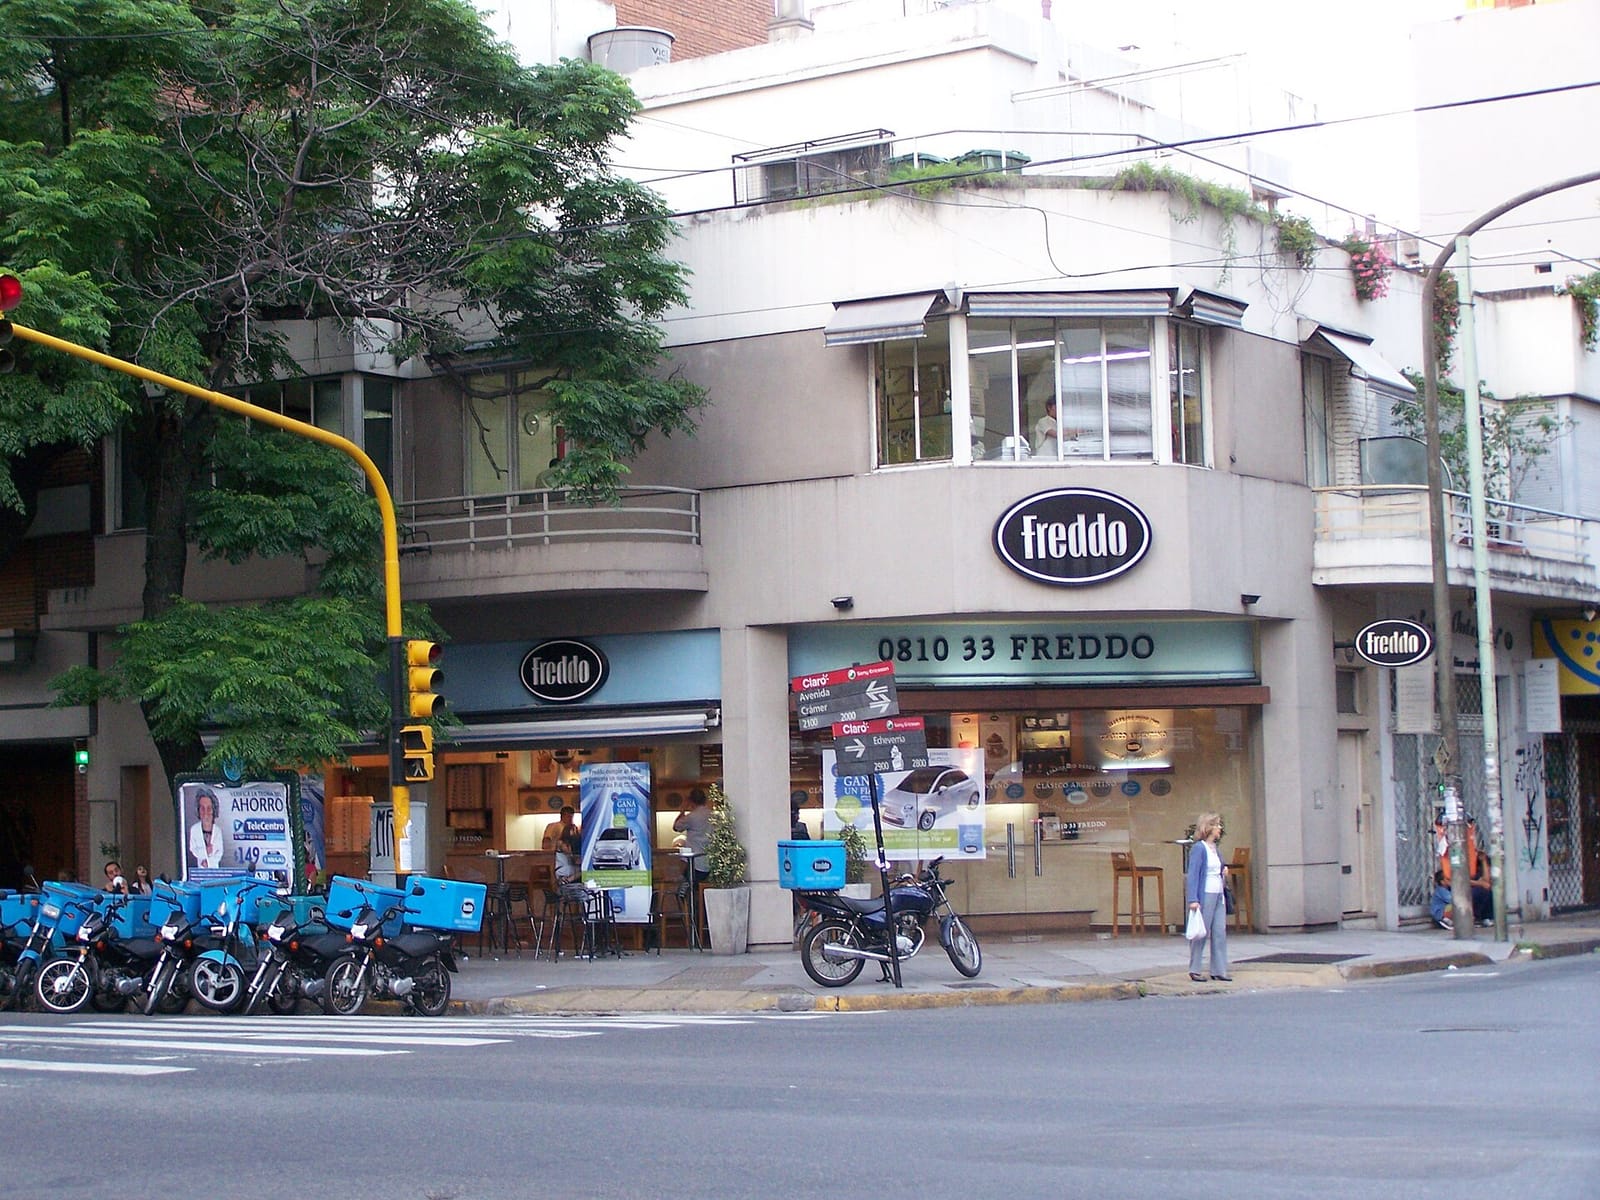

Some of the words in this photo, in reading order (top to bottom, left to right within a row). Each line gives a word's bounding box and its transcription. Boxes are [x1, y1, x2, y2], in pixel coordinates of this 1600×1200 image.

[877, 637, 950, 662] 0810
[962, 637, 996, 661] 33
[1010, 634, 1155, 661] FREDDO
[802, 674, 829, 689] Claro
[799, 688, 831, 702] Avenida
[802, 718, 818, 728] 2100
[840, 711, 857, 722] 2000
[842, 721, 869, 734] Claro
[874, 761, 889, 771] 2900
[911, 758, 927, 768] 2800
[844, 787, 858, 795] UN
[231, 797, 284, 812] AHORRO
[247, 820, 285, 831] TeleCentro
[1078, 820, 1107, 829] FREDDO
